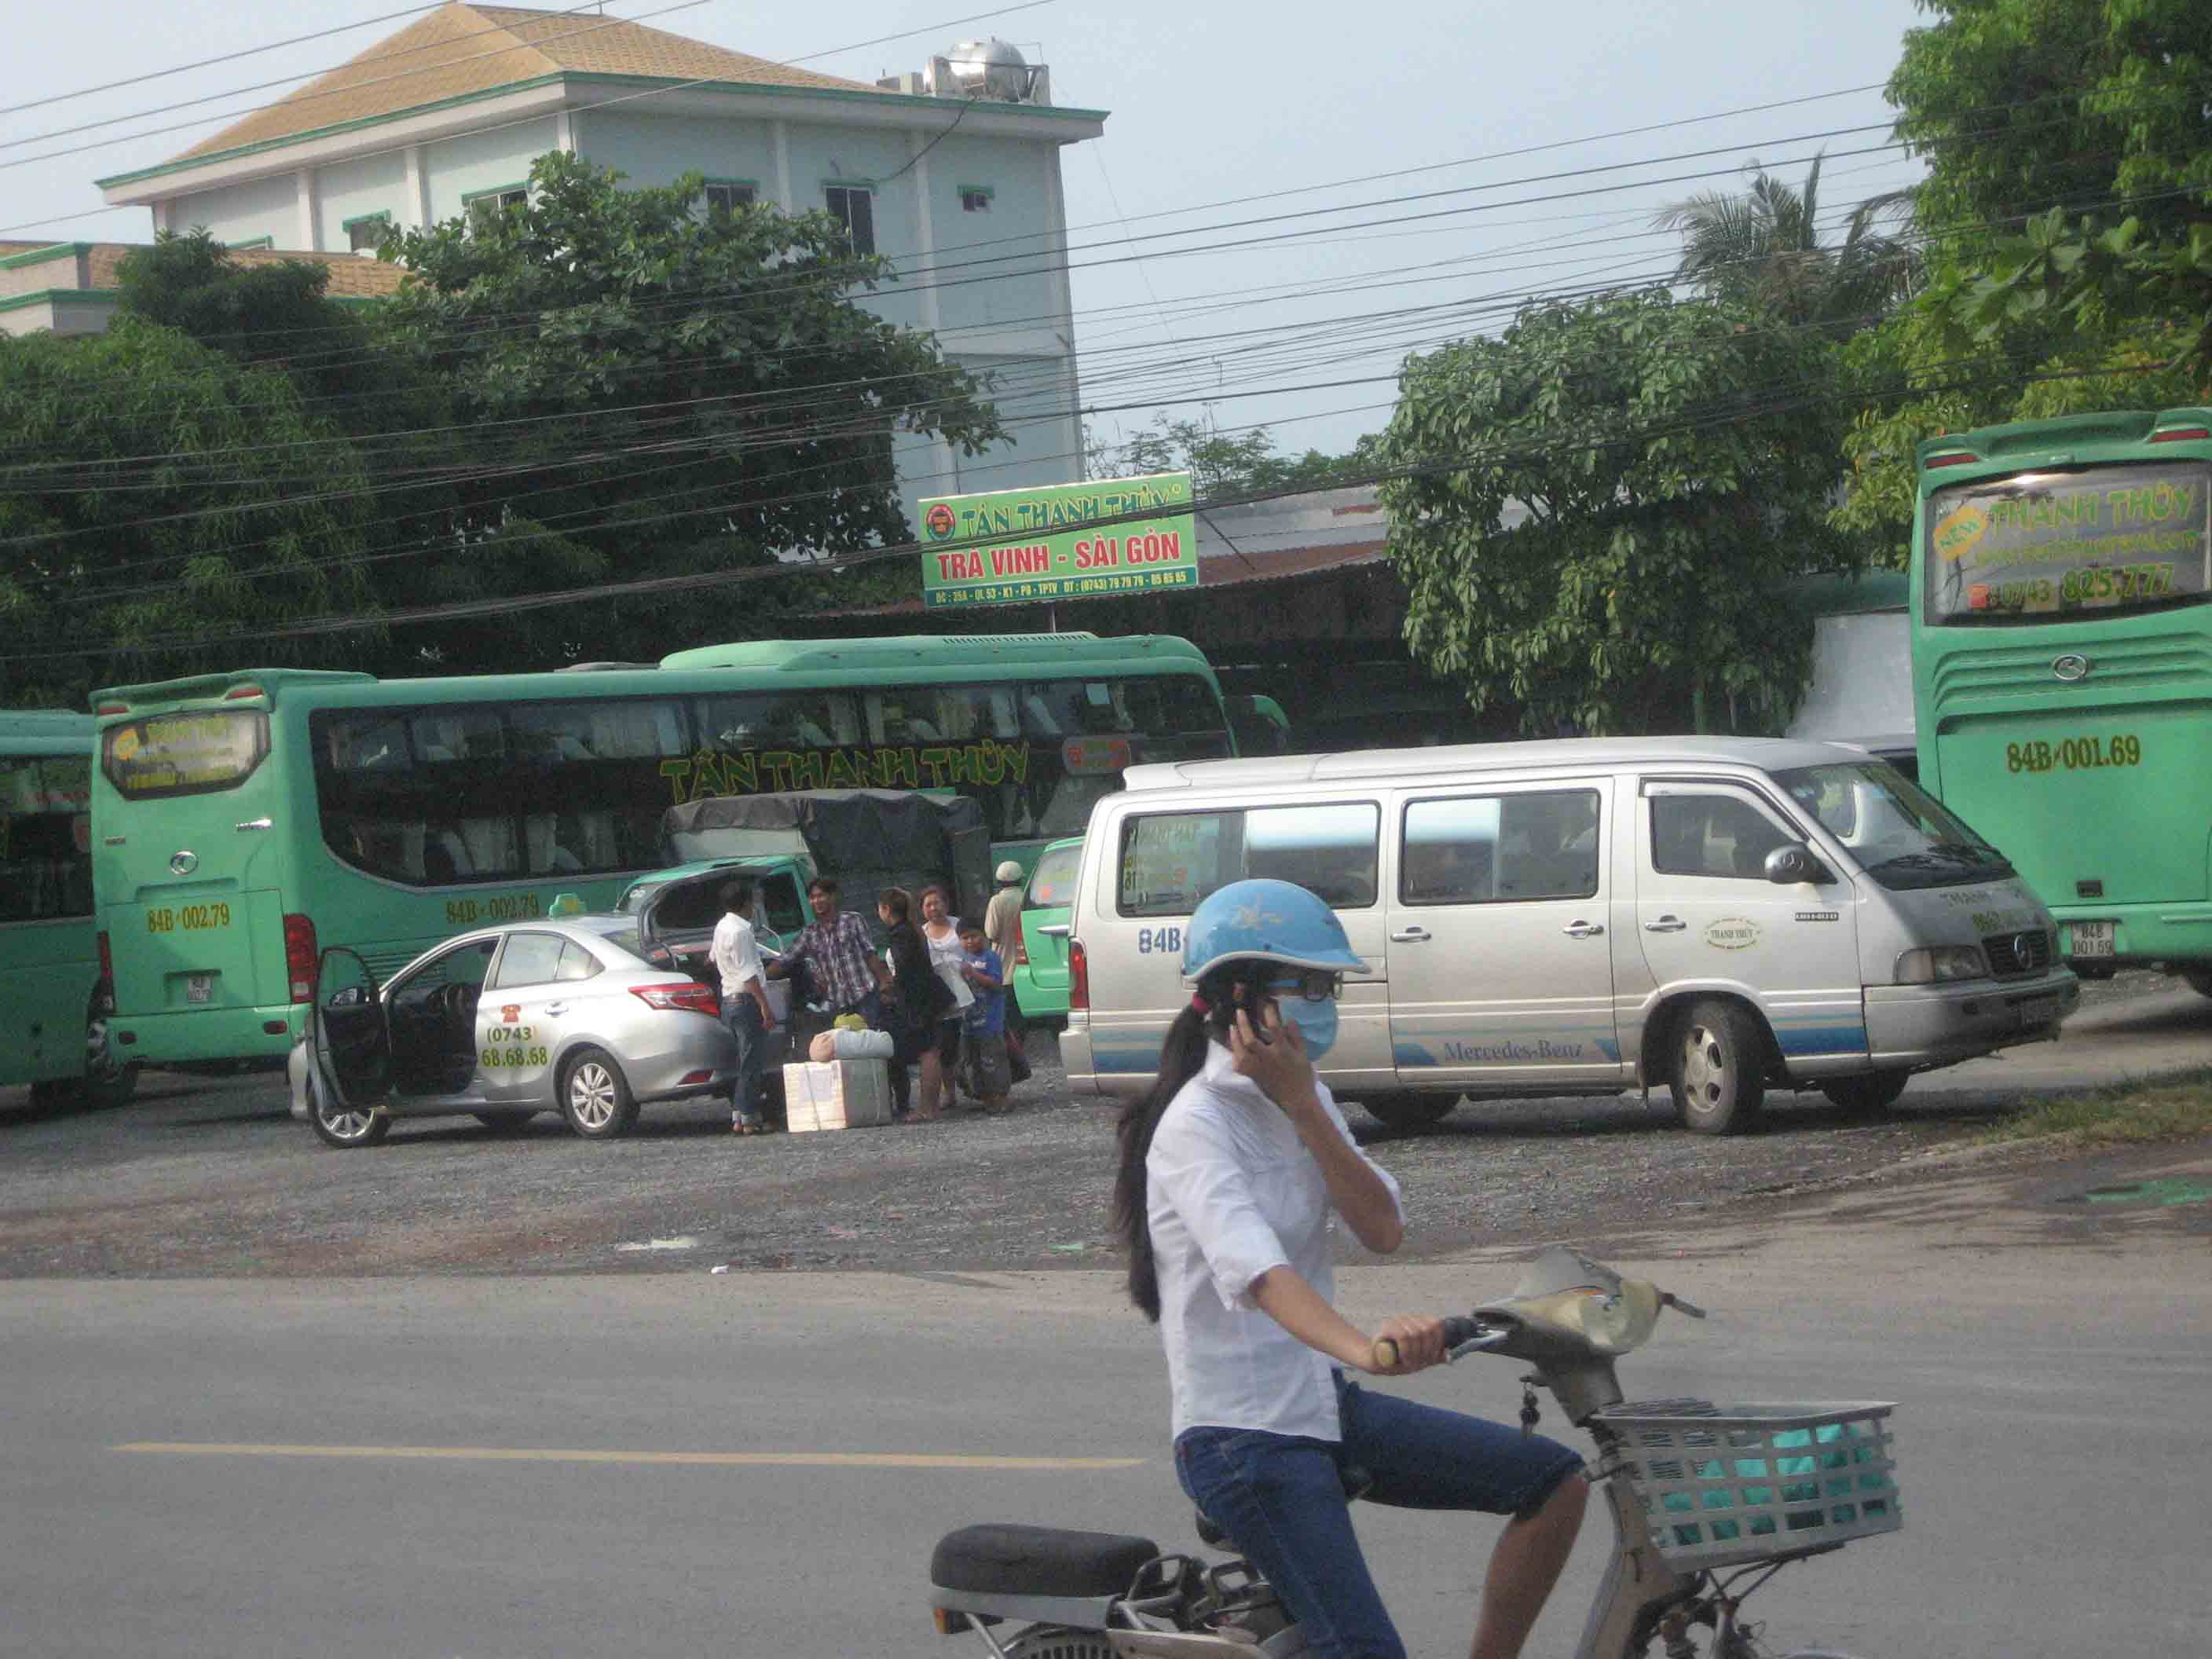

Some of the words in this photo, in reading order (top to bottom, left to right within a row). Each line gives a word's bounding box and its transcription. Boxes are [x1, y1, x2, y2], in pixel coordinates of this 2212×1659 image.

[961, 502, 1012, 540] TÂN
[1017, 491, 1100, 531] THANH
[937, 546, 983, 580] TRÀ
[991, 544, 1050, 576] VINH
[1075, 534, 1119, 569] SÀI
[1126, 527, 1181, 566] GÒN
[659, 749, 759, 804] TÂN
[760, 745, 917, 792] THANH
[482, 1046, 548, 1067] 68.68.68
